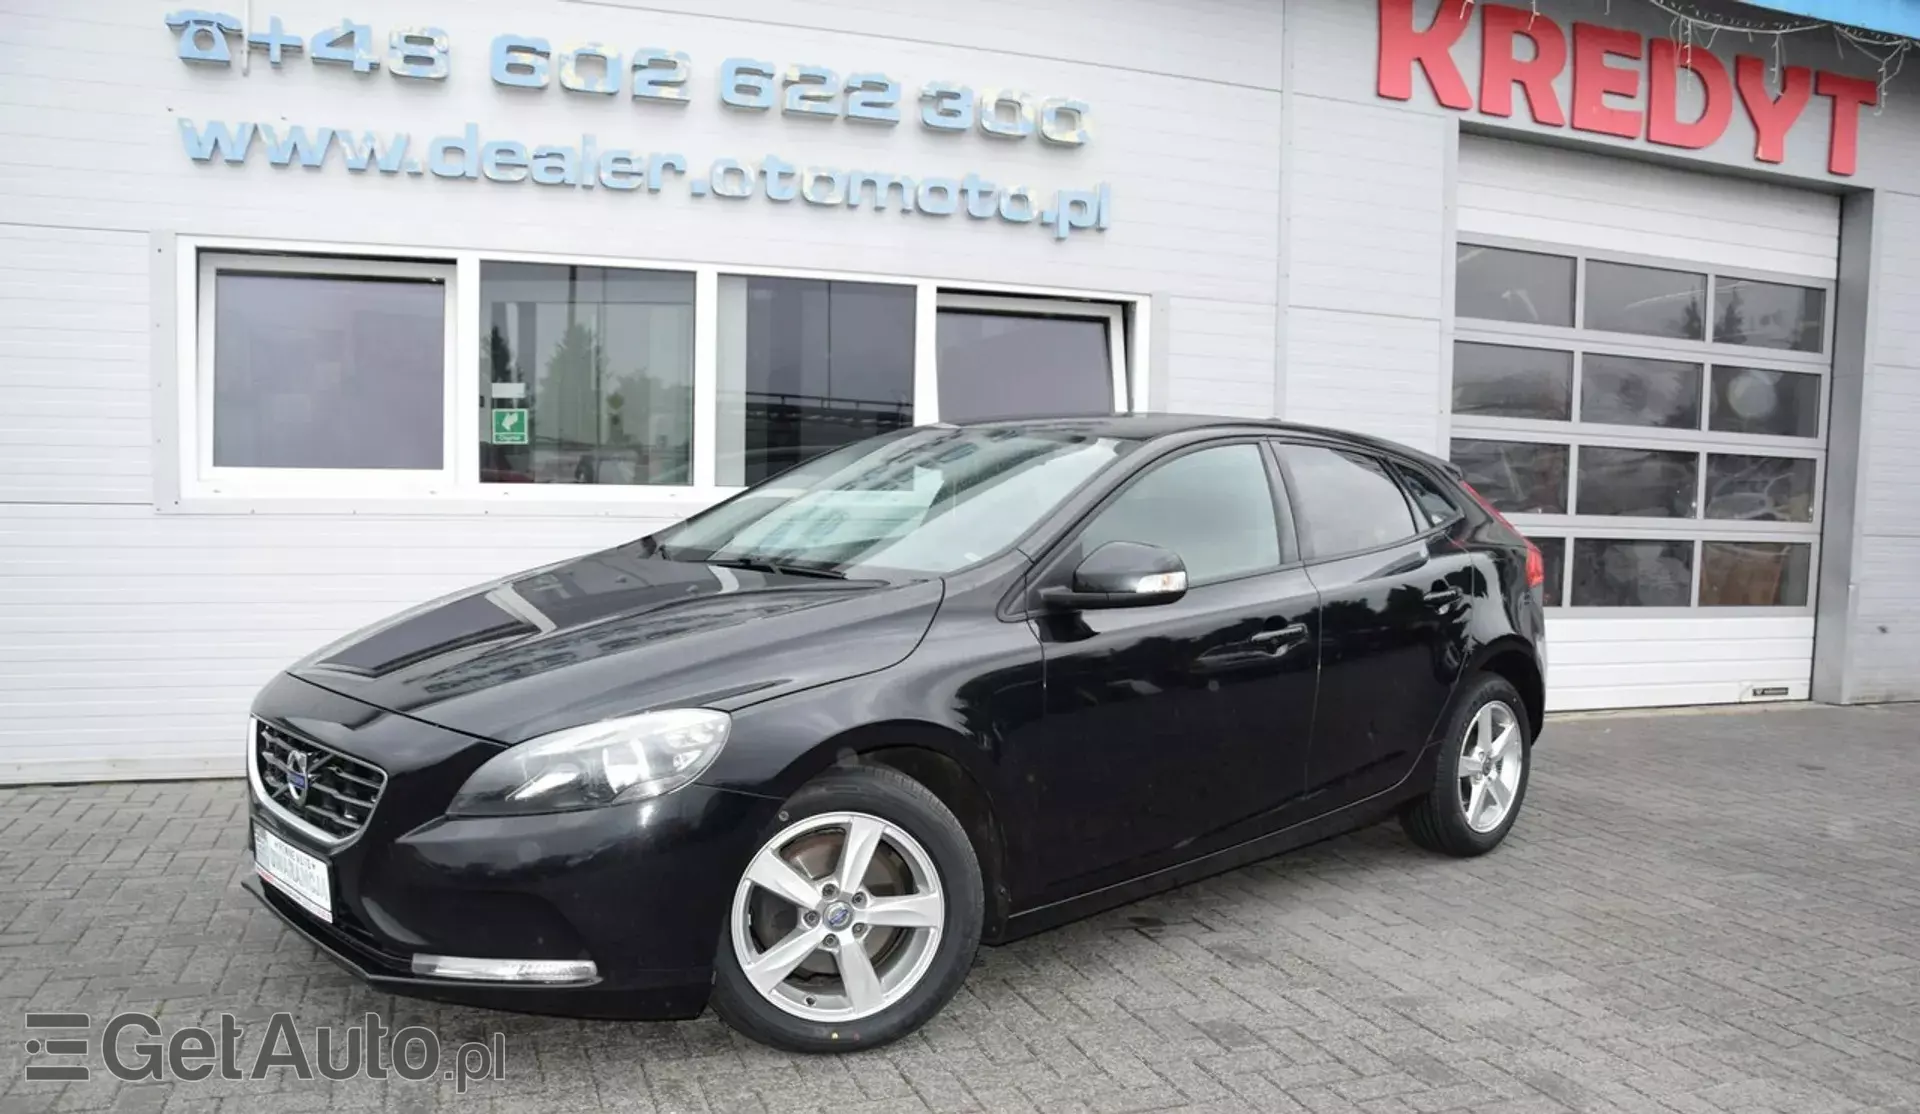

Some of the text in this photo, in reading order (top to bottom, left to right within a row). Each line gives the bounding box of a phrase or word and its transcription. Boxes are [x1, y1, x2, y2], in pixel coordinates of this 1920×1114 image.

[246, 14, 1096, 149] +48 602 622 300
[1377, 0, 1878, 177] KREDYT
[177, 116, 1112, 240] www.dealer.otomoto.pl
